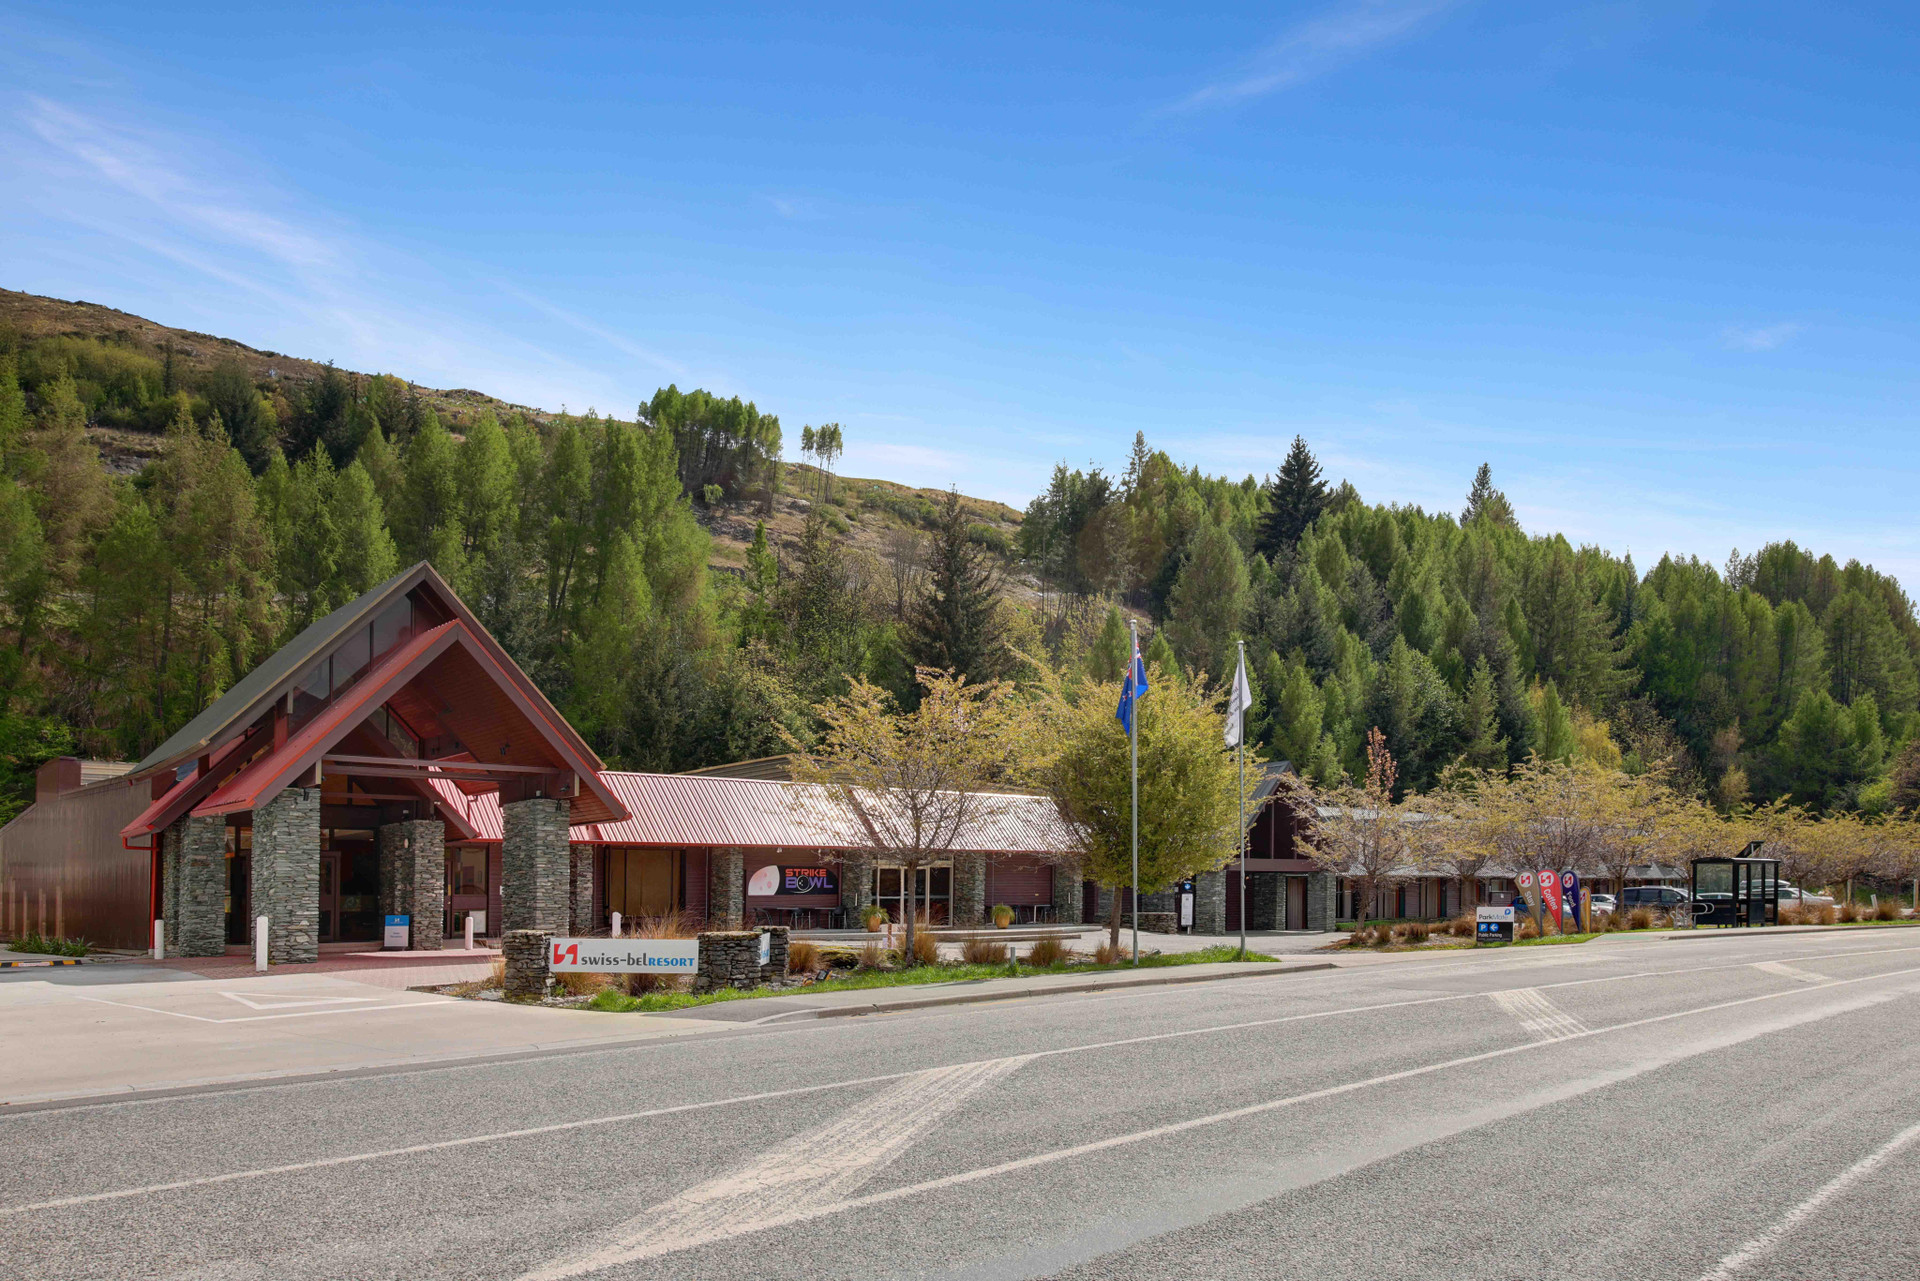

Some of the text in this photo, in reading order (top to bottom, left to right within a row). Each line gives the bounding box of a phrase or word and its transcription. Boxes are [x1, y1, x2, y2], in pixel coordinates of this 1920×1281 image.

[785, 868, 827, 877] STRIKE
[785, 875, 834, 891] BOWL
[1524, 890, 1536, 907] Stay
[1543, 888, 1558, 911] Coffee
[1566, 890, 1577, 908] Food
